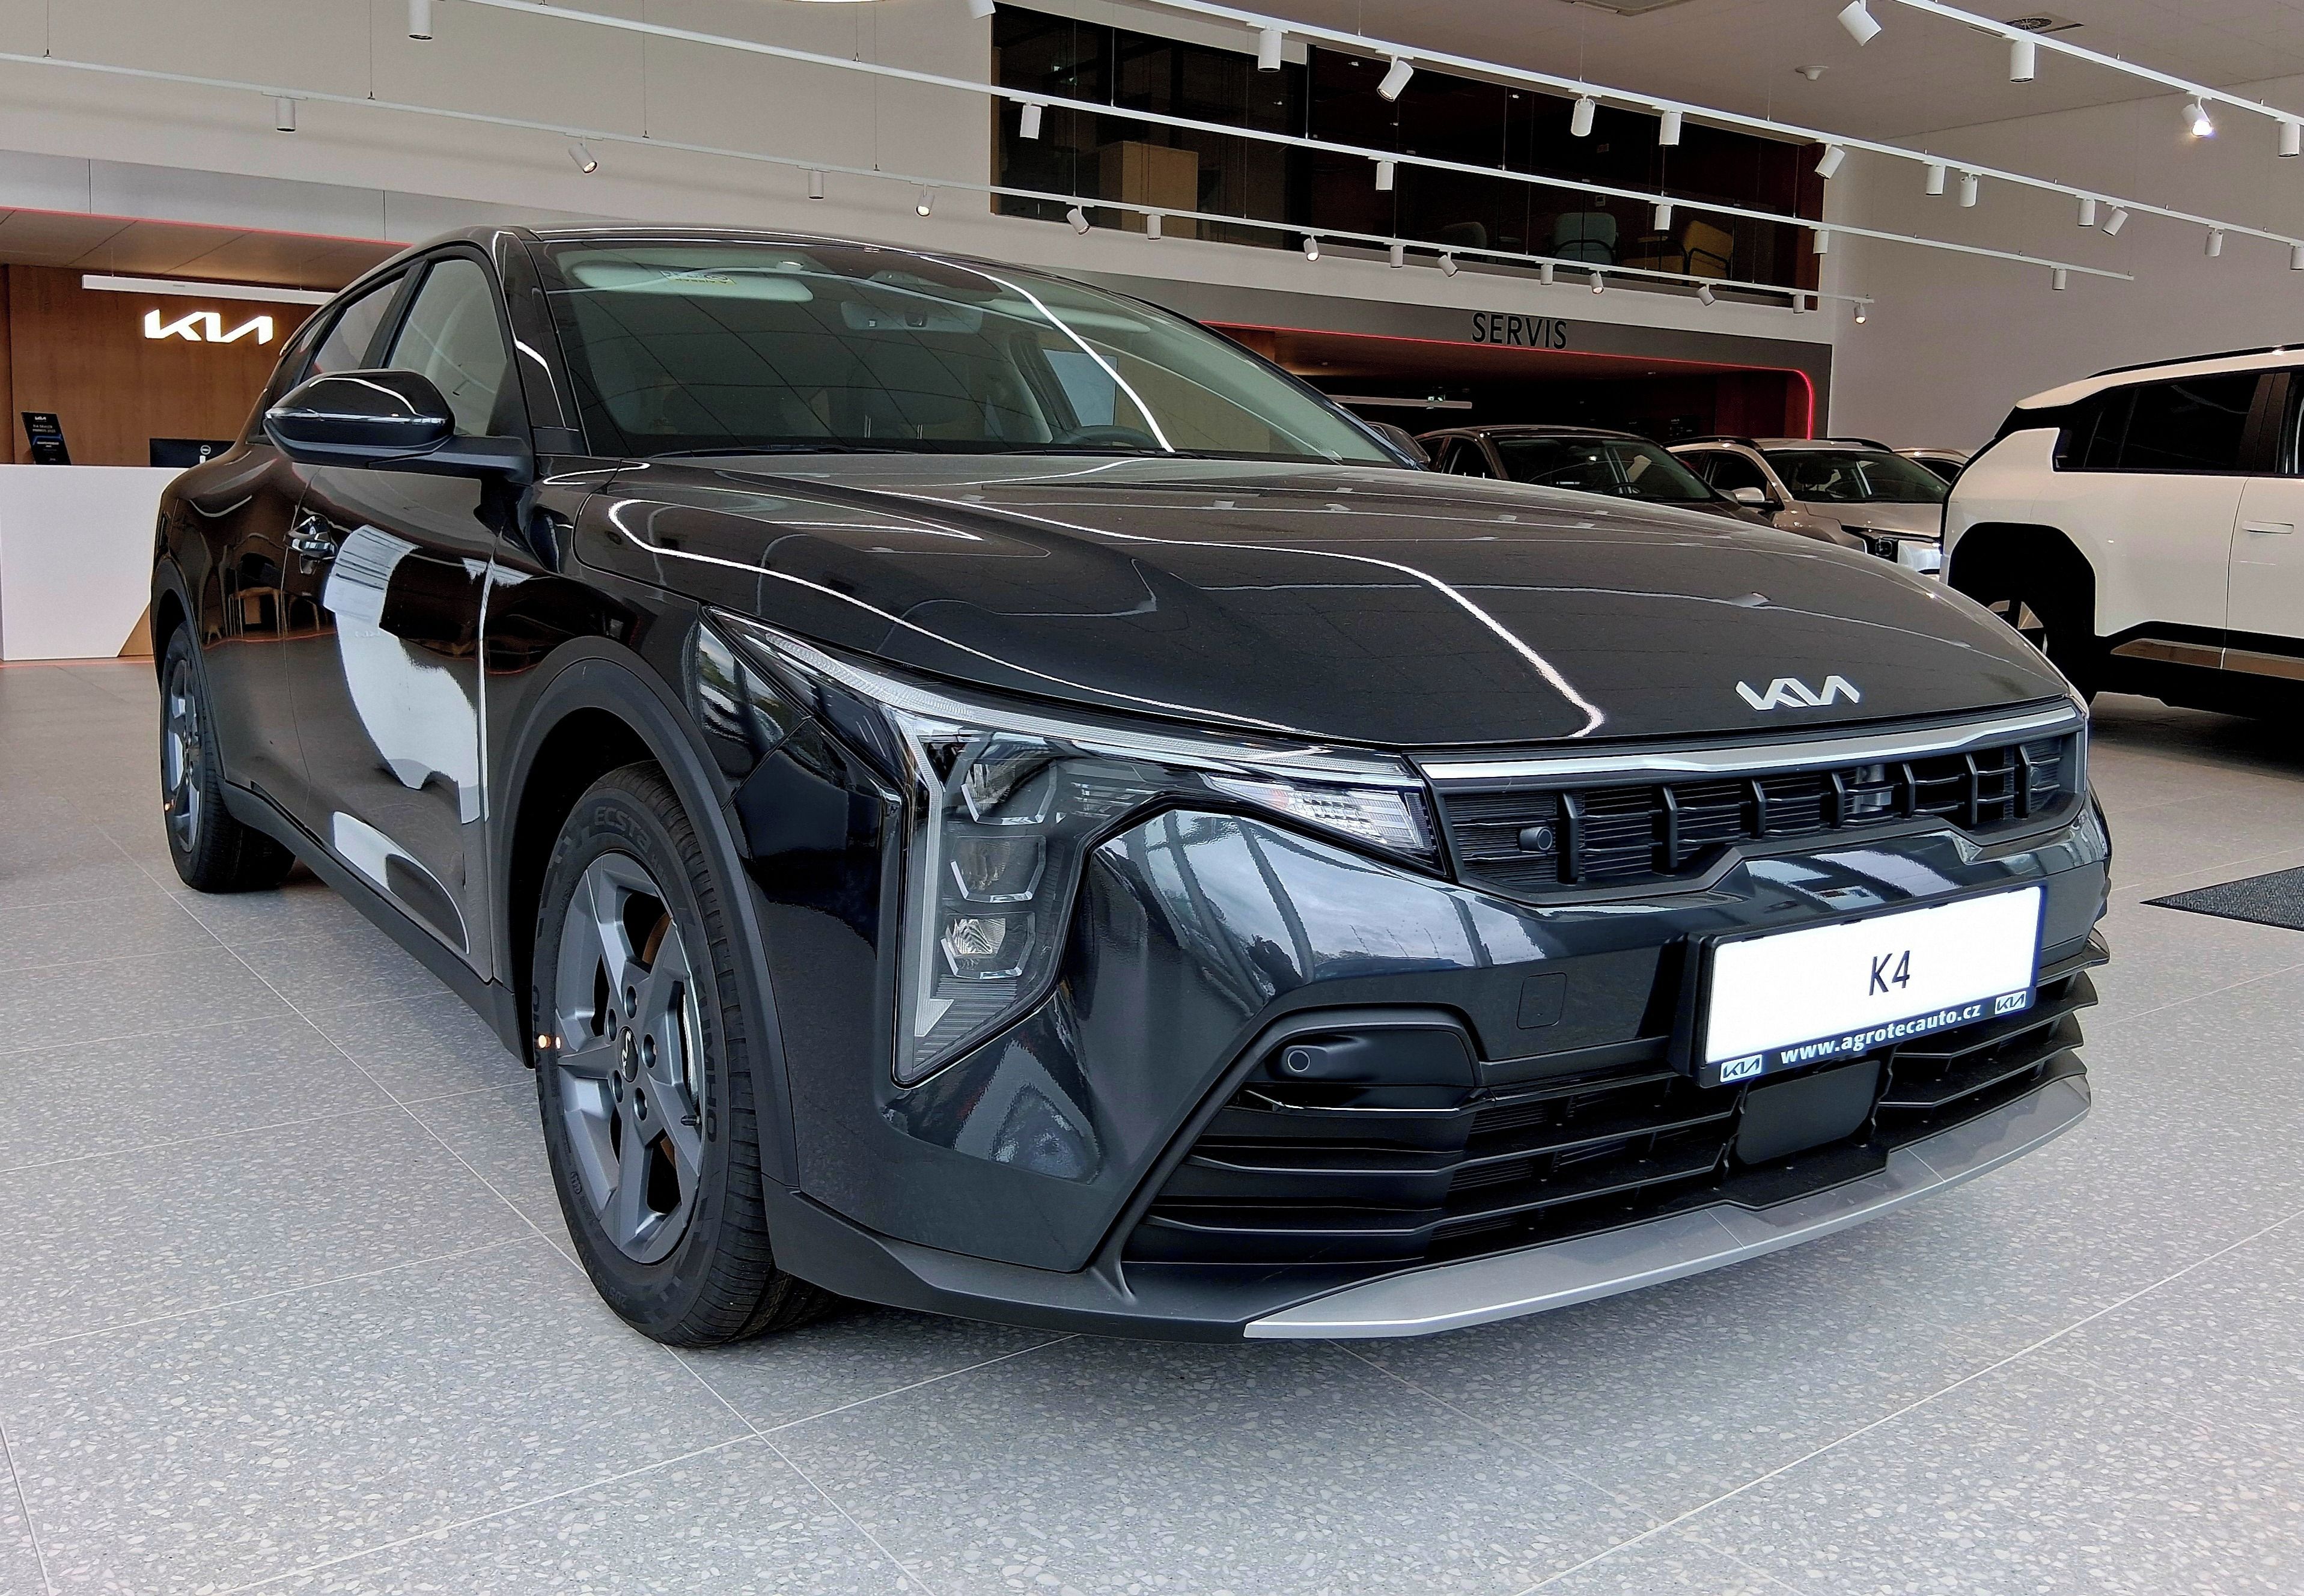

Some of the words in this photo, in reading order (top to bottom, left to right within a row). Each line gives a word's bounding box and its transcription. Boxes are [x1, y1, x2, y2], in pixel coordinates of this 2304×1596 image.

[144, 309, 273, 345] KIA
[1472, 312, 1567, 349] SERVIS
[1736, 675, 1860, 710] KIA
[1869, 950, 1910, 996] K4
[1997, 993, 2025, 1011] KIA
[1781, 1005, 1981, 1064] www.agrotecauto.cz
[1723, 1058, 1760, 1078] KIA
